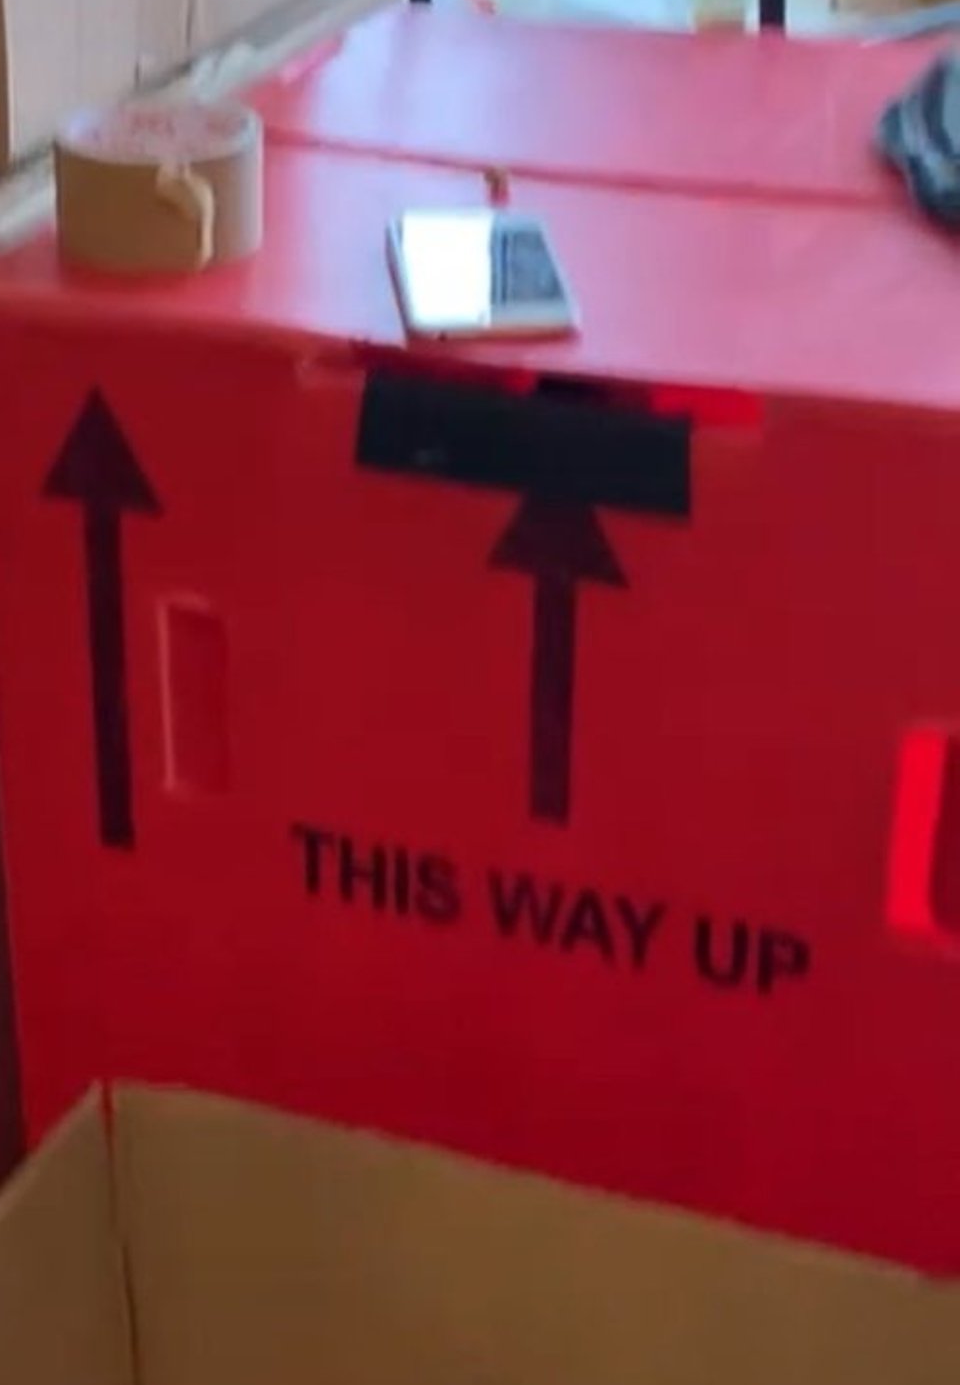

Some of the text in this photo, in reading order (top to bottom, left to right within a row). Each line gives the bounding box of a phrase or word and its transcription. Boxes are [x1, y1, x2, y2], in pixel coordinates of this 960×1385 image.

[291, 823, 811, 997] THIS WAY UP
